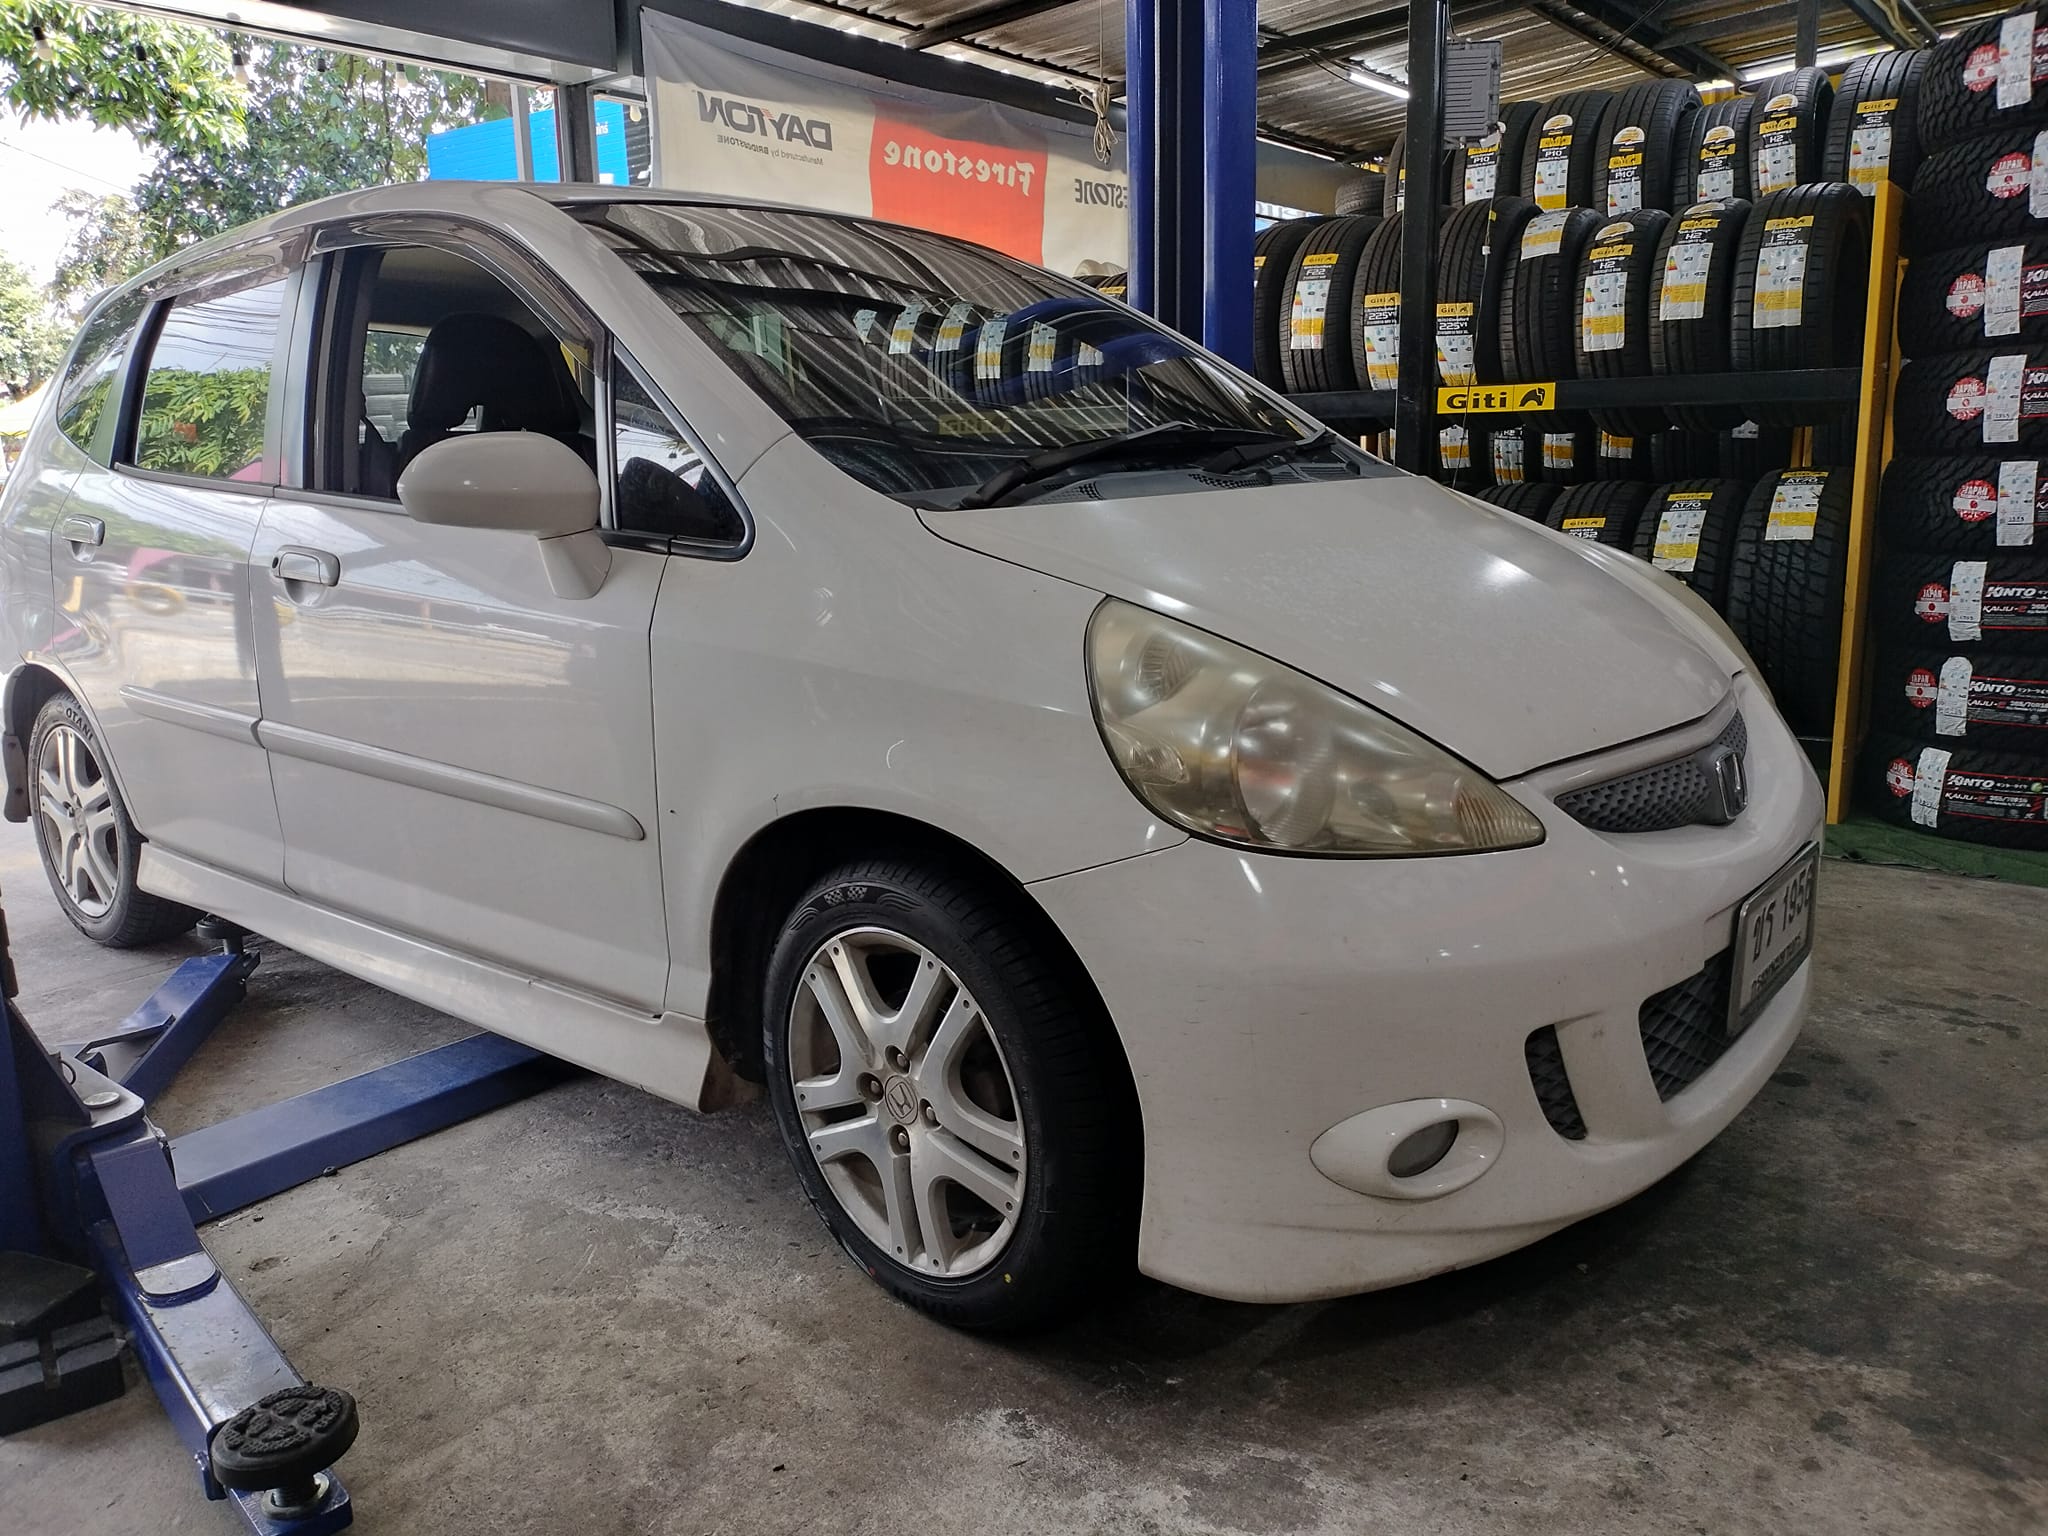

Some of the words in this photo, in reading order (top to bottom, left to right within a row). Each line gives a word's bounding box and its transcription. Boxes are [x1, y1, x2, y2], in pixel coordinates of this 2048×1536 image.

[1685, 232, 1703, 240] H2
[1776, 233, 1795, 241] S2
[1600, 260, 1616, 269] H2
[1306, 268, 1326, 276] F22
[1956, 280, 1977, 291] JAPAN
[1446, 391, 1508, 409] Giti
[1671, 501, 1702, 509] AT70
[1923, 589, 1942, 598] JAPAN
[1985, 586, 2036, 598] KINTO
[1911, 674, 1929, 683] JAPAN
[1969, 680, 2016, 693] KINTO
[65, 707, 94, 741] OTANI
[1948, 774, 1995, 788] KINTO
